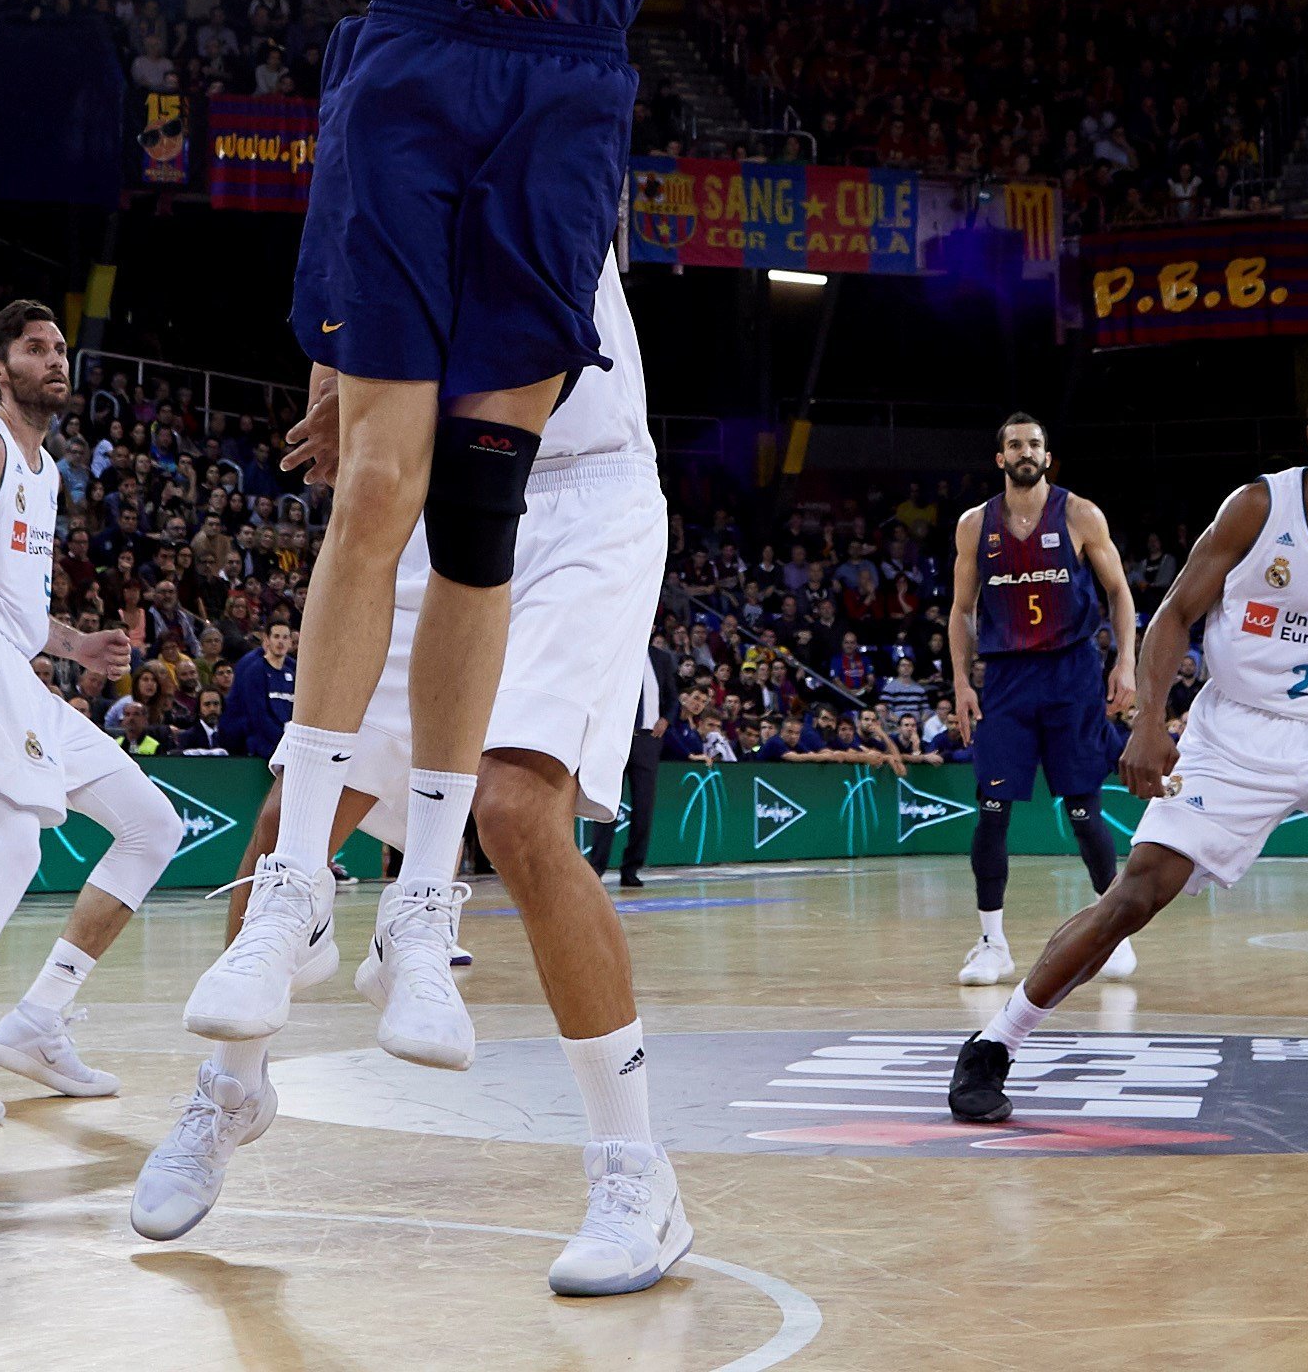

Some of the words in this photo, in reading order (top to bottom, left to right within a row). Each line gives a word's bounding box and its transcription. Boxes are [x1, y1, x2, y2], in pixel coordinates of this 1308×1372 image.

[144, 92, 181, 125] 15
[702, 175, 794, 225] SANG
[837, 179, 911, 228] CULÉ
[707, 227, 767, 249] COR
[1093, 255, 1289, 319] P.B.B.
[1009, 568, 1070, 584] LASSA
[1028, 594, 1042, 625] 5
